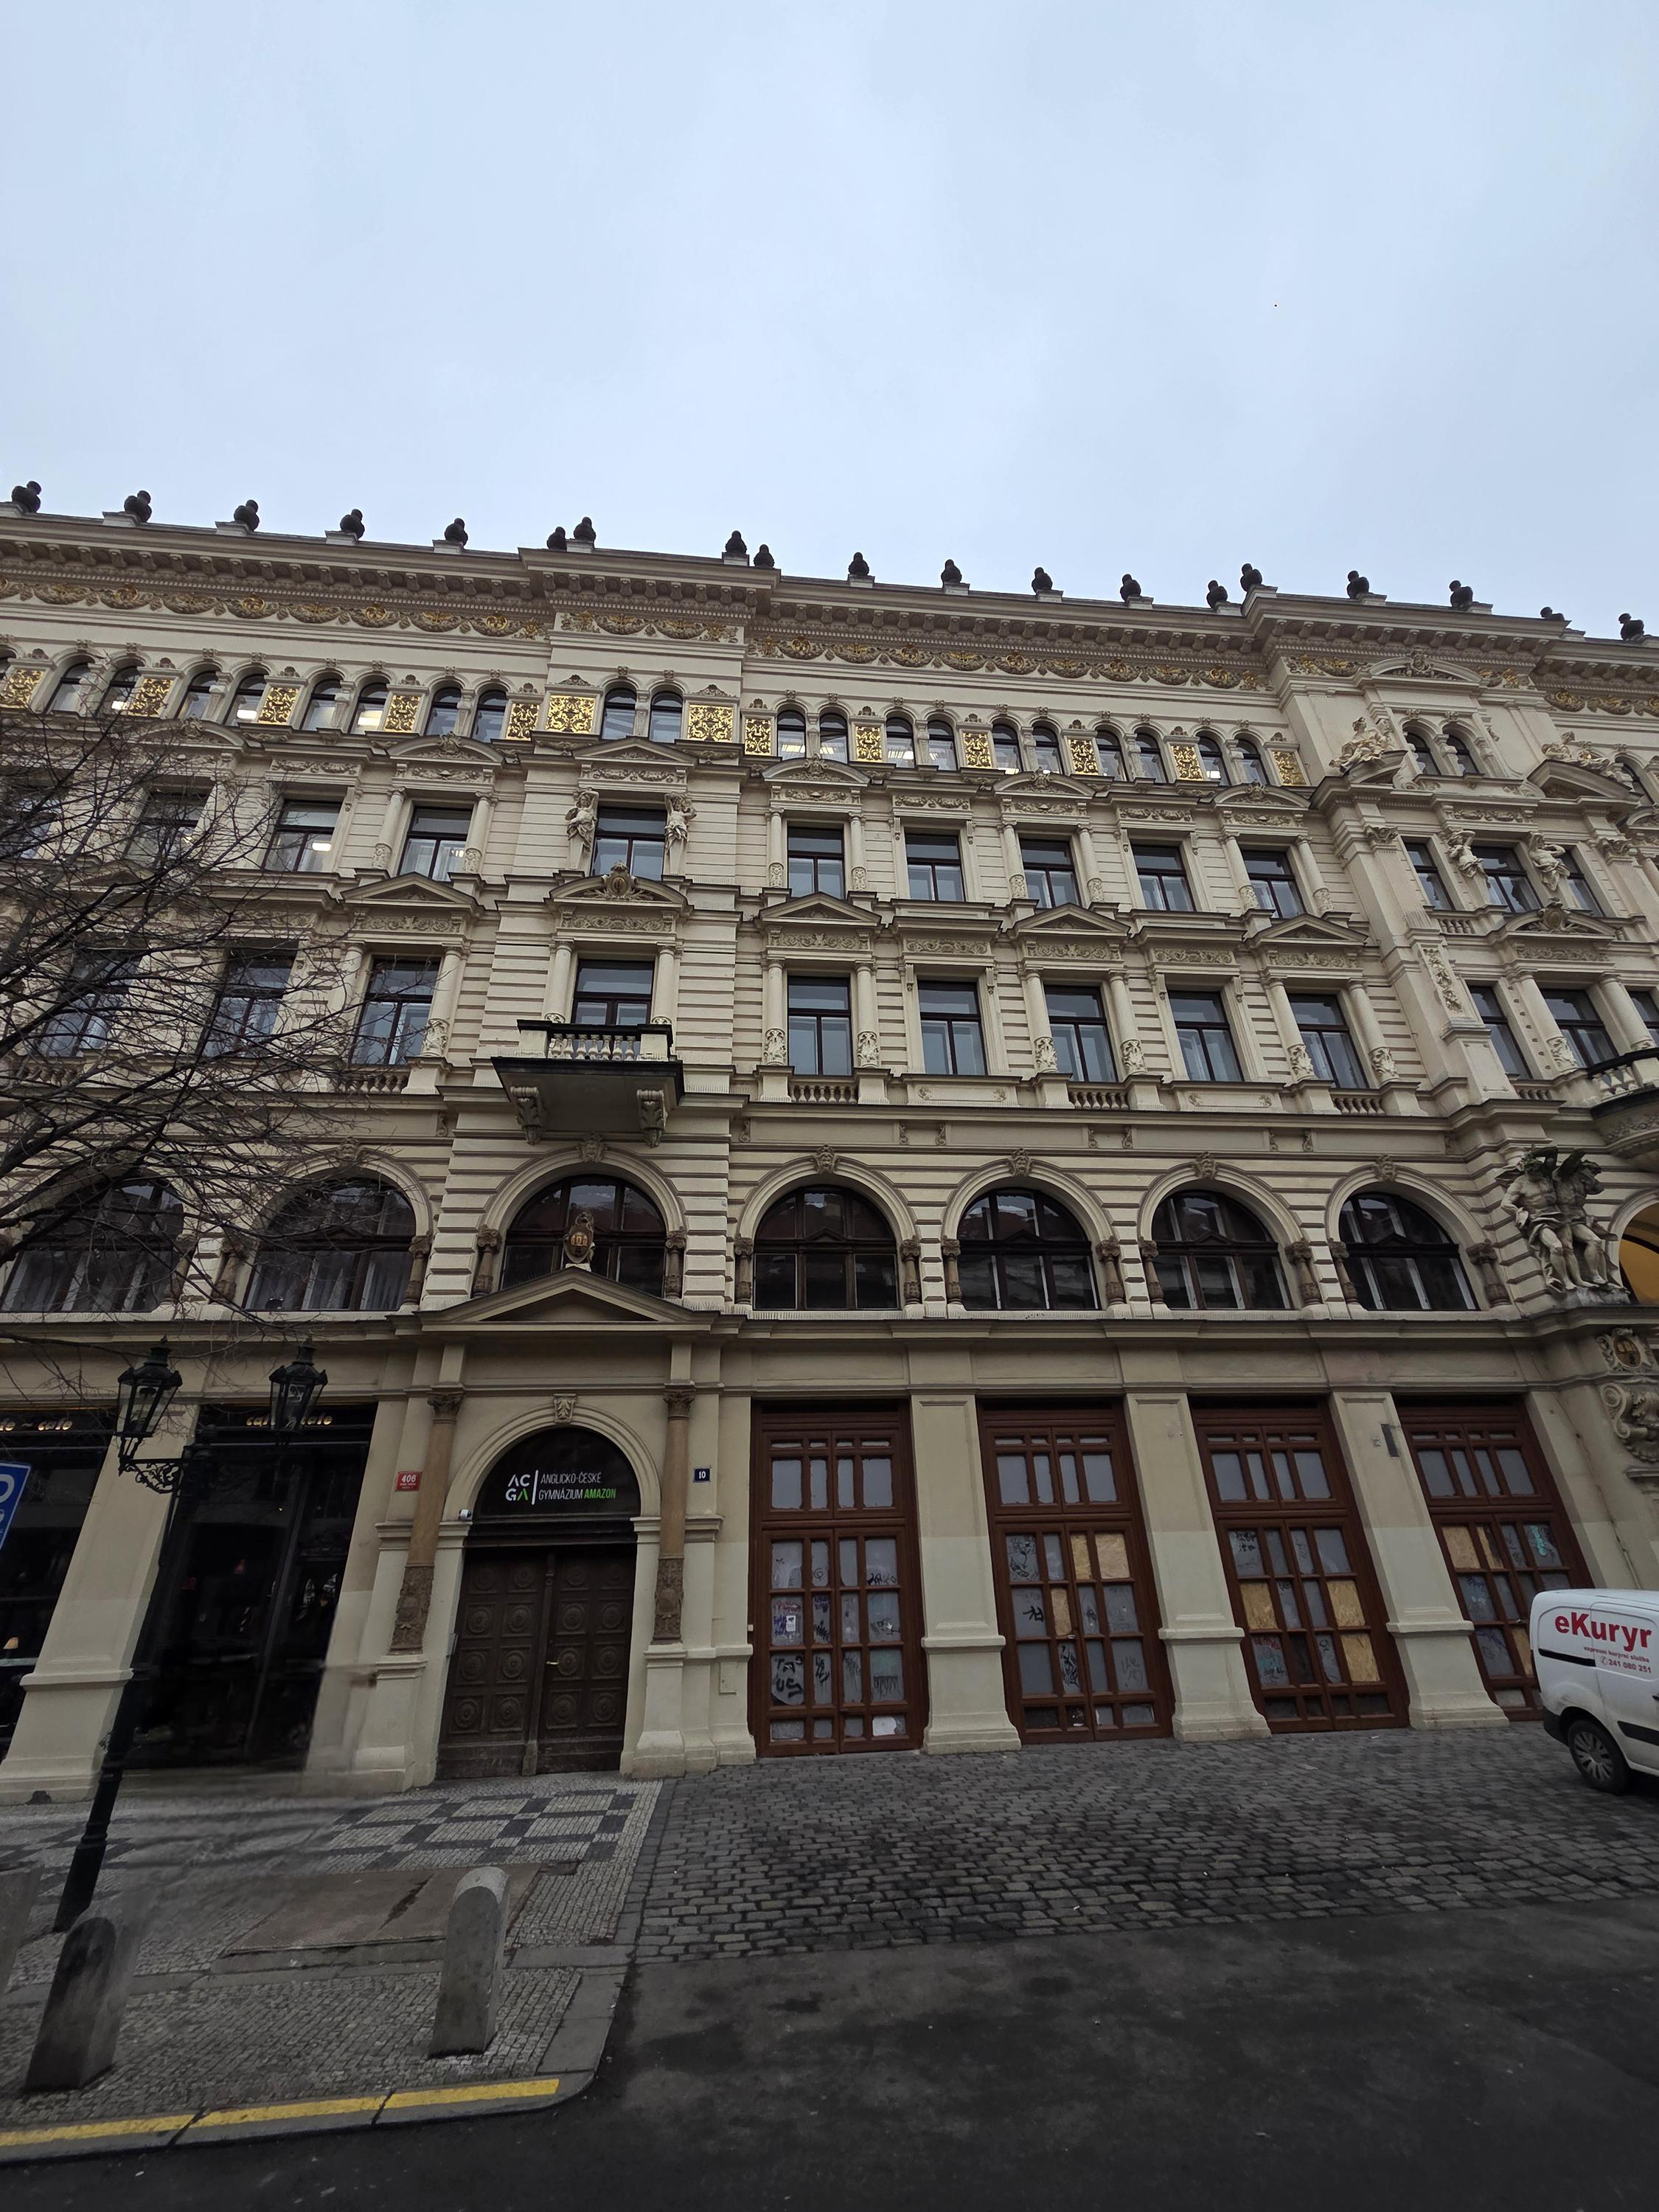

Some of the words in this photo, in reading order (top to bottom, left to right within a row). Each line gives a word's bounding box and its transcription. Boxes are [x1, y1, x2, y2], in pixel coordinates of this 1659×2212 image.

[401, 1474, 417, 1483] 406
[540, 1472, 602, 1484] ANGLICKO-ČESKÉ
[698, 1470, 706, 1479] 10
[538, 1486, 584, 1500] GYMNÁZIUM
[584, 1488, 616, 1499] AMAZON
[1555, 1612, 1652, 1652] eKuryr
[1608, 1658, 1621, 1668] 241
[1623, 1661, 1636, 1671] 080
[1638, 1664, 1652, 1674] 251
